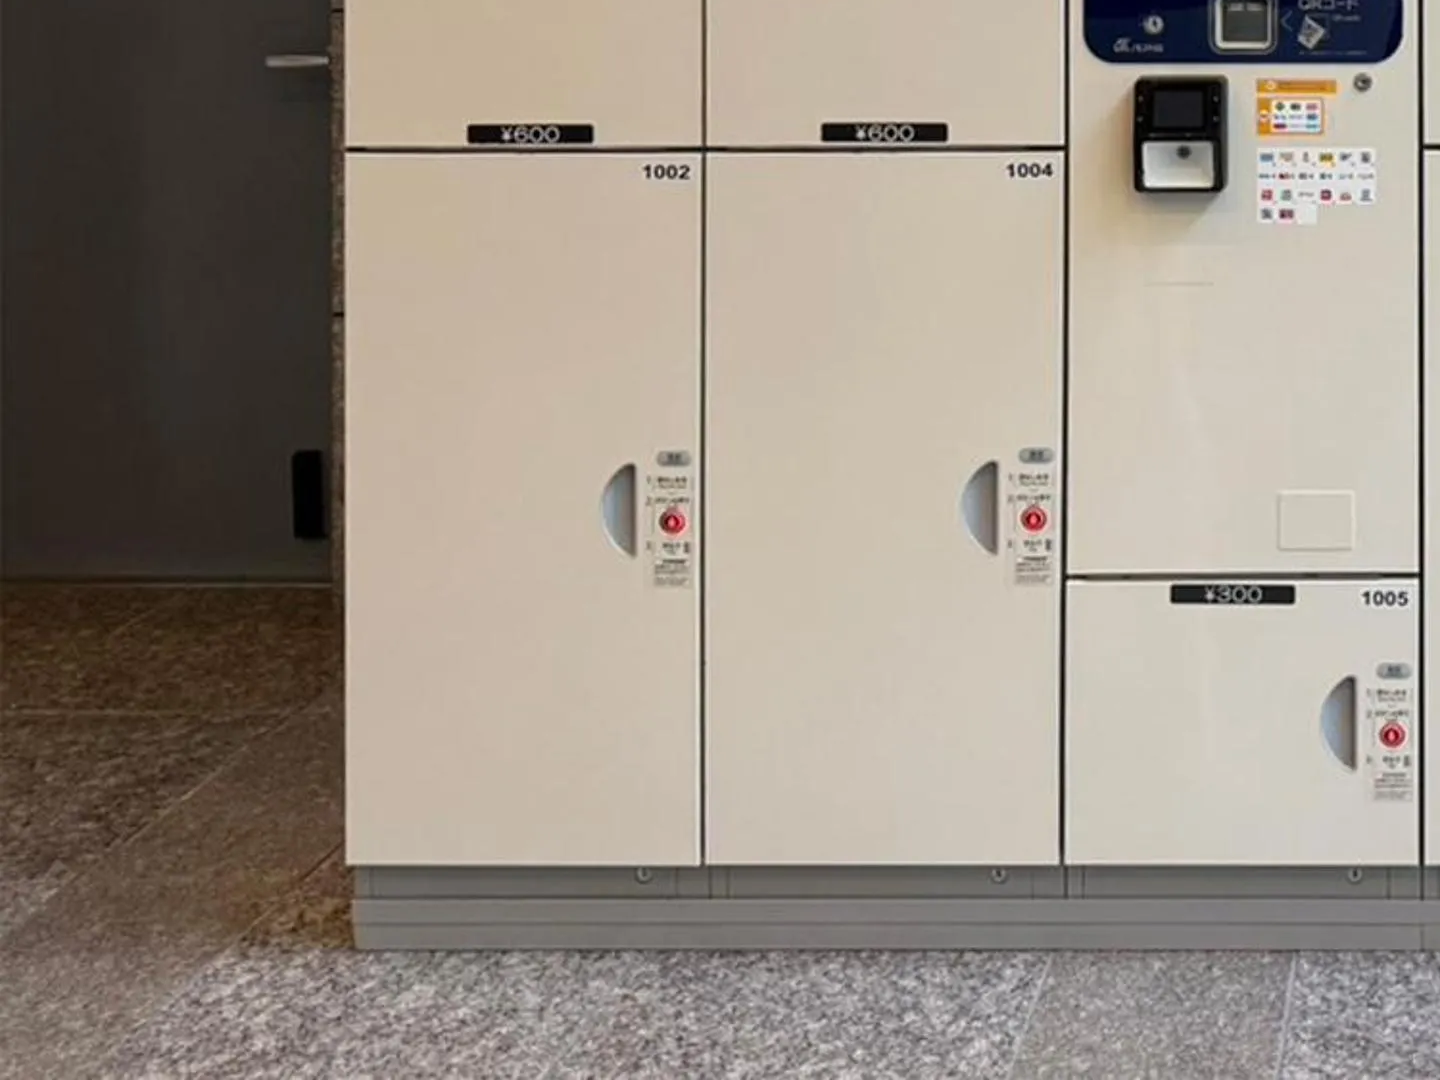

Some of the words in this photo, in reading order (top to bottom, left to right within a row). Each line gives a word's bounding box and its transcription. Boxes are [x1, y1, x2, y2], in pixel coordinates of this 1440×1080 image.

[501, 126, 561, 143] ¥600
[855, 125, 915, 142] ¥600
[643, 164, 691, 180] 1002
[1006, 163, 1053, 178] 1004
[1204, 586, 1263, 603] ¥300
[1362, 590, 1409, 607] 1005
